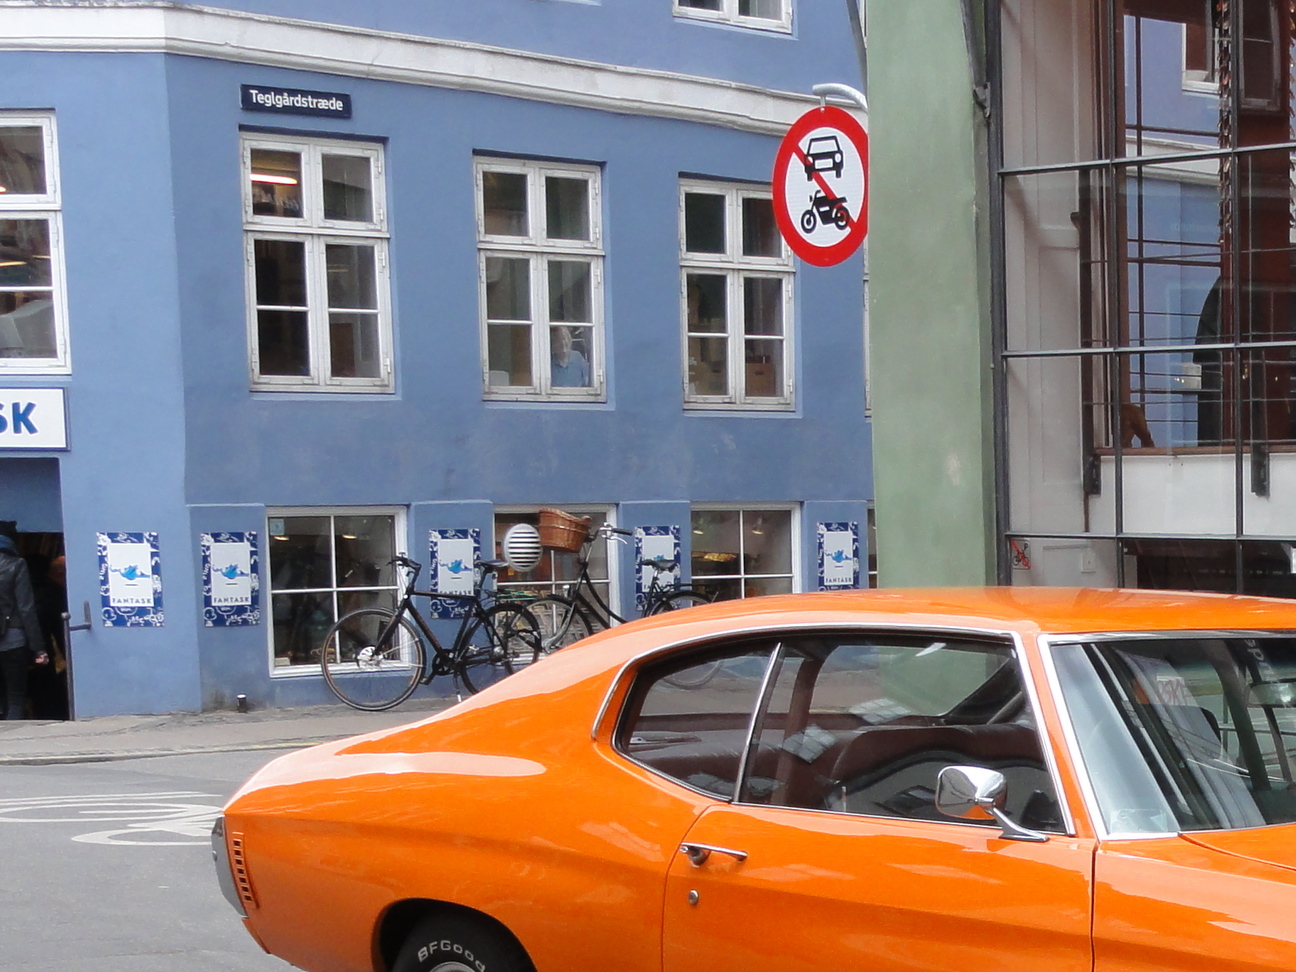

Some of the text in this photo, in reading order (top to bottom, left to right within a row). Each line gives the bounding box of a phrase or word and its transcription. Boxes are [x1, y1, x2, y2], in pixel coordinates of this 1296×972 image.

[249, 89, 344, 111] Teglgårdstræde
[112, 597, 152, 605] FANTASK
[213, 596, 250, 604] FANTASK
